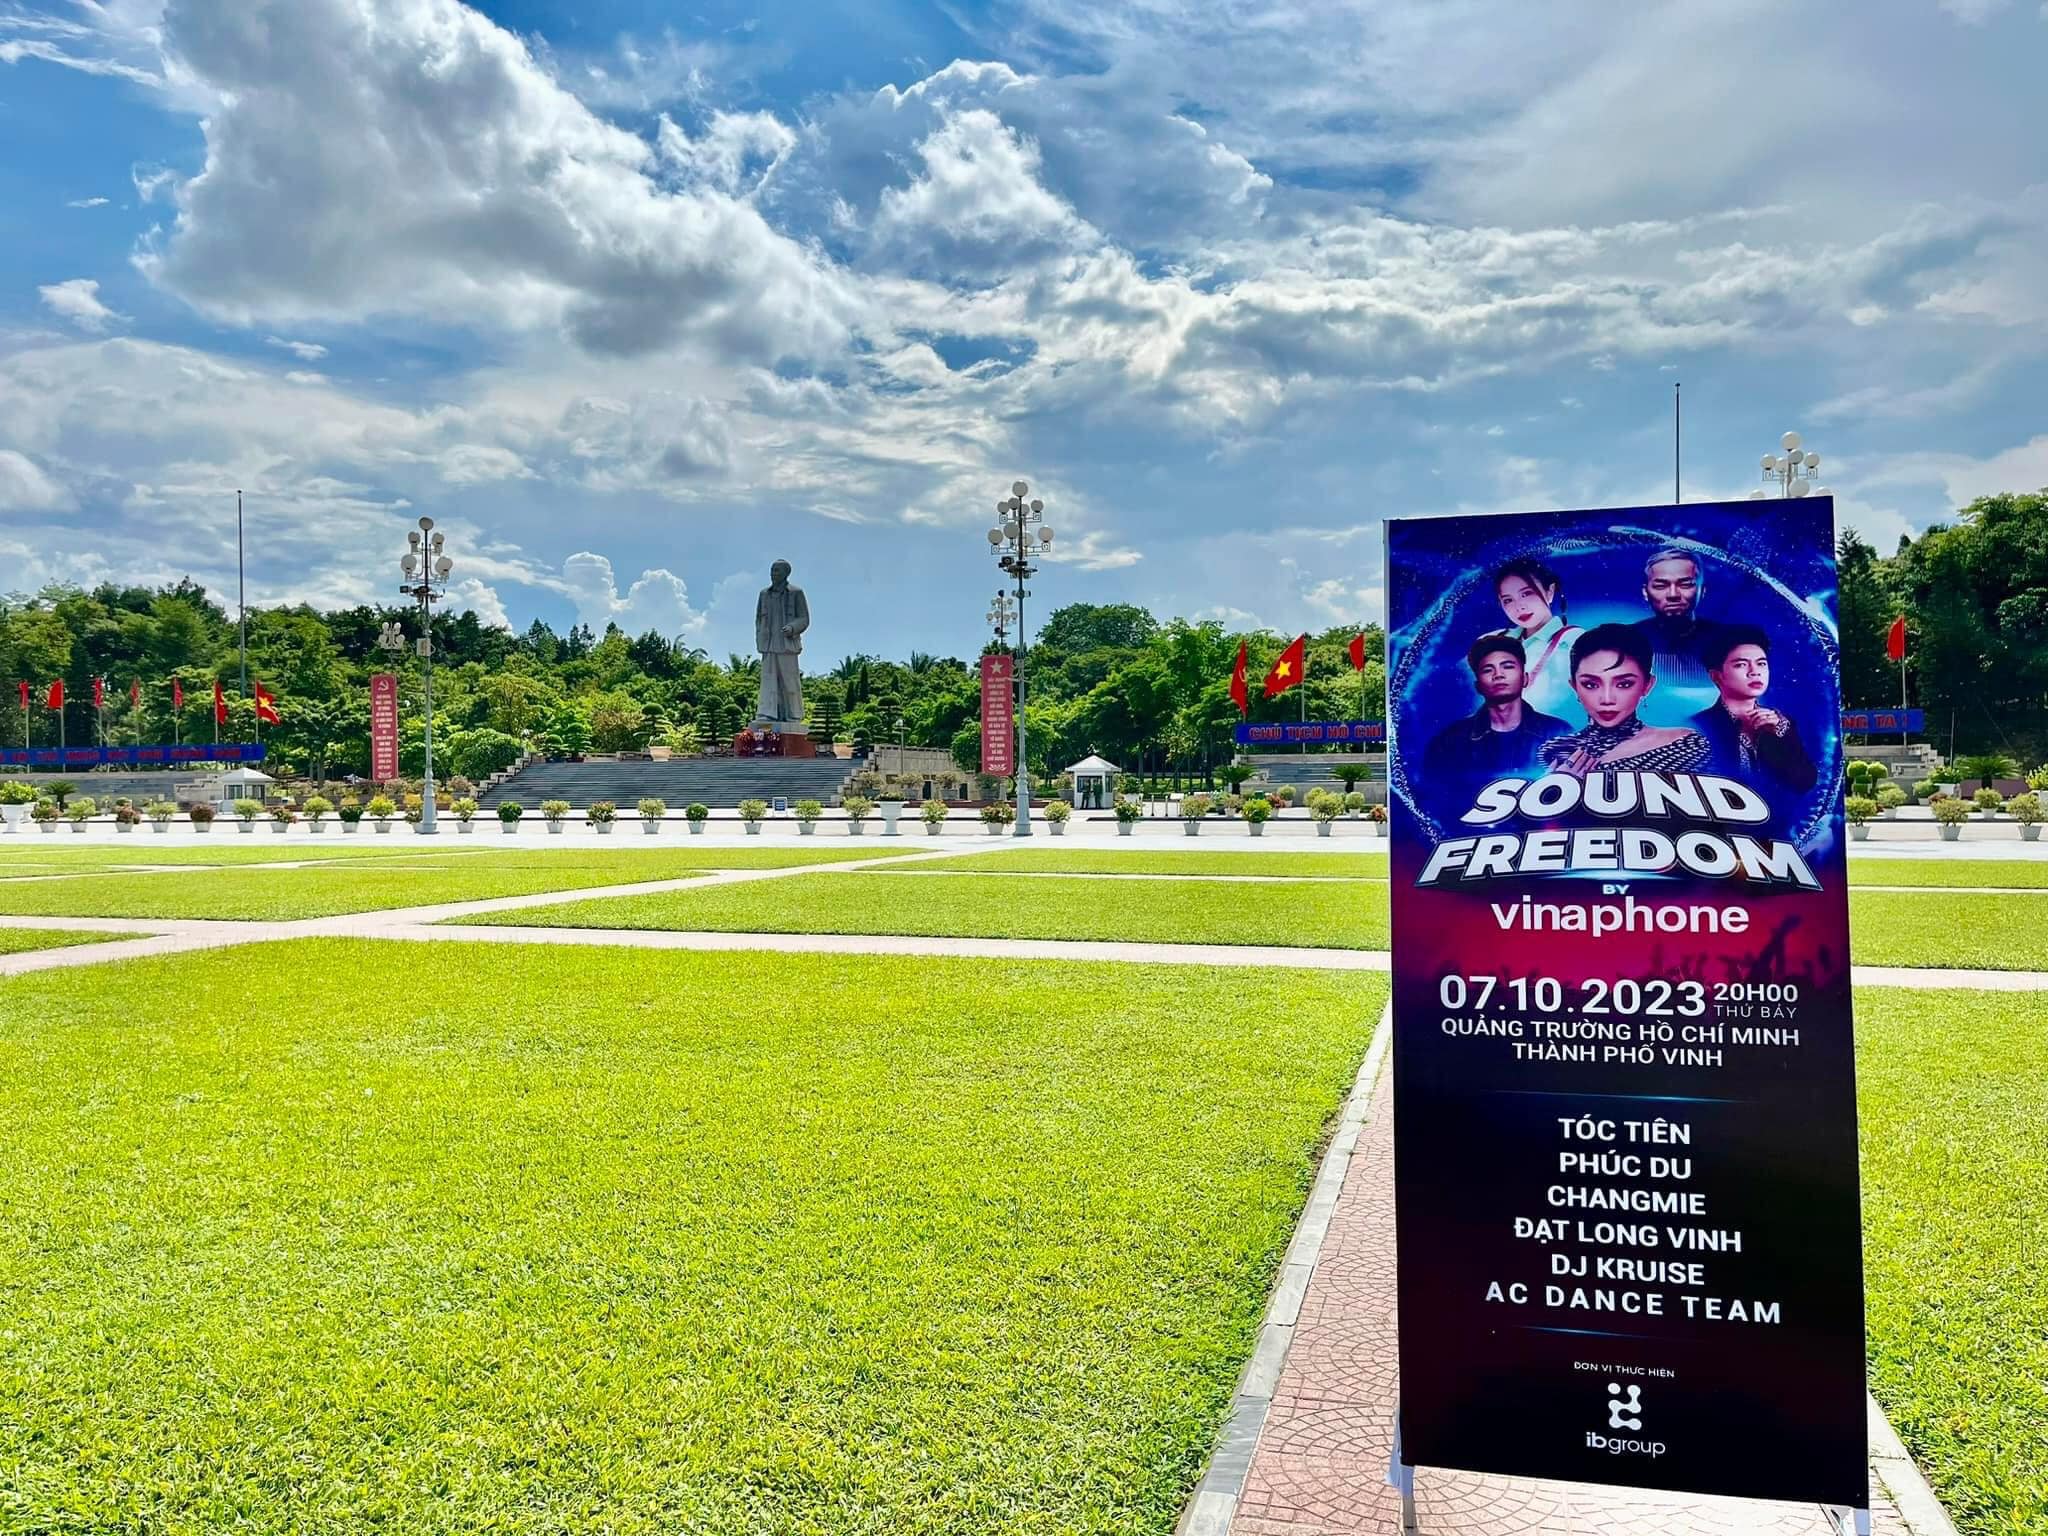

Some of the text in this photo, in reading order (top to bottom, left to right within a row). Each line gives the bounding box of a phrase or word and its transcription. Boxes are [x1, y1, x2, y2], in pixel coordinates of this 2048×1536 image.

[1461, 771, 1770, 824] SOUND
[1417, 831, 1824, 891] FREEDOM
[1602, 884, 1630, 895] BY
[1491, 895, 1749, 937] vinaphone
[1440, 975, 1706, 1016] 07.10.2023
[1713, 982, 1798, 1003] 20H00
[1713, 1003, 1754, 1018] THỨ
[1441, 1014, 1800, 1046] QUẢNG TRƯỜNG HỒ CHÍ MINH
[1511, 1040, 1723, 1067] THÀNH PHỐ VINH
[1558, 1113, 1690, 1145] TÓC TIÊN
[1559, 1150, 1692, 1179] PHÚC DU
[1547, 1185, 1706, 1215] CHANGMIE
[1514, 1217, 1742, 1252] ĐẠT LONG VINH
[1551, 1253, 1705, 1285] DJ KRUISE
[1485, 1281, 1781, 1324] AC DANCE TEAM
[1586, 1431, 1666, 1459] ibgroup
